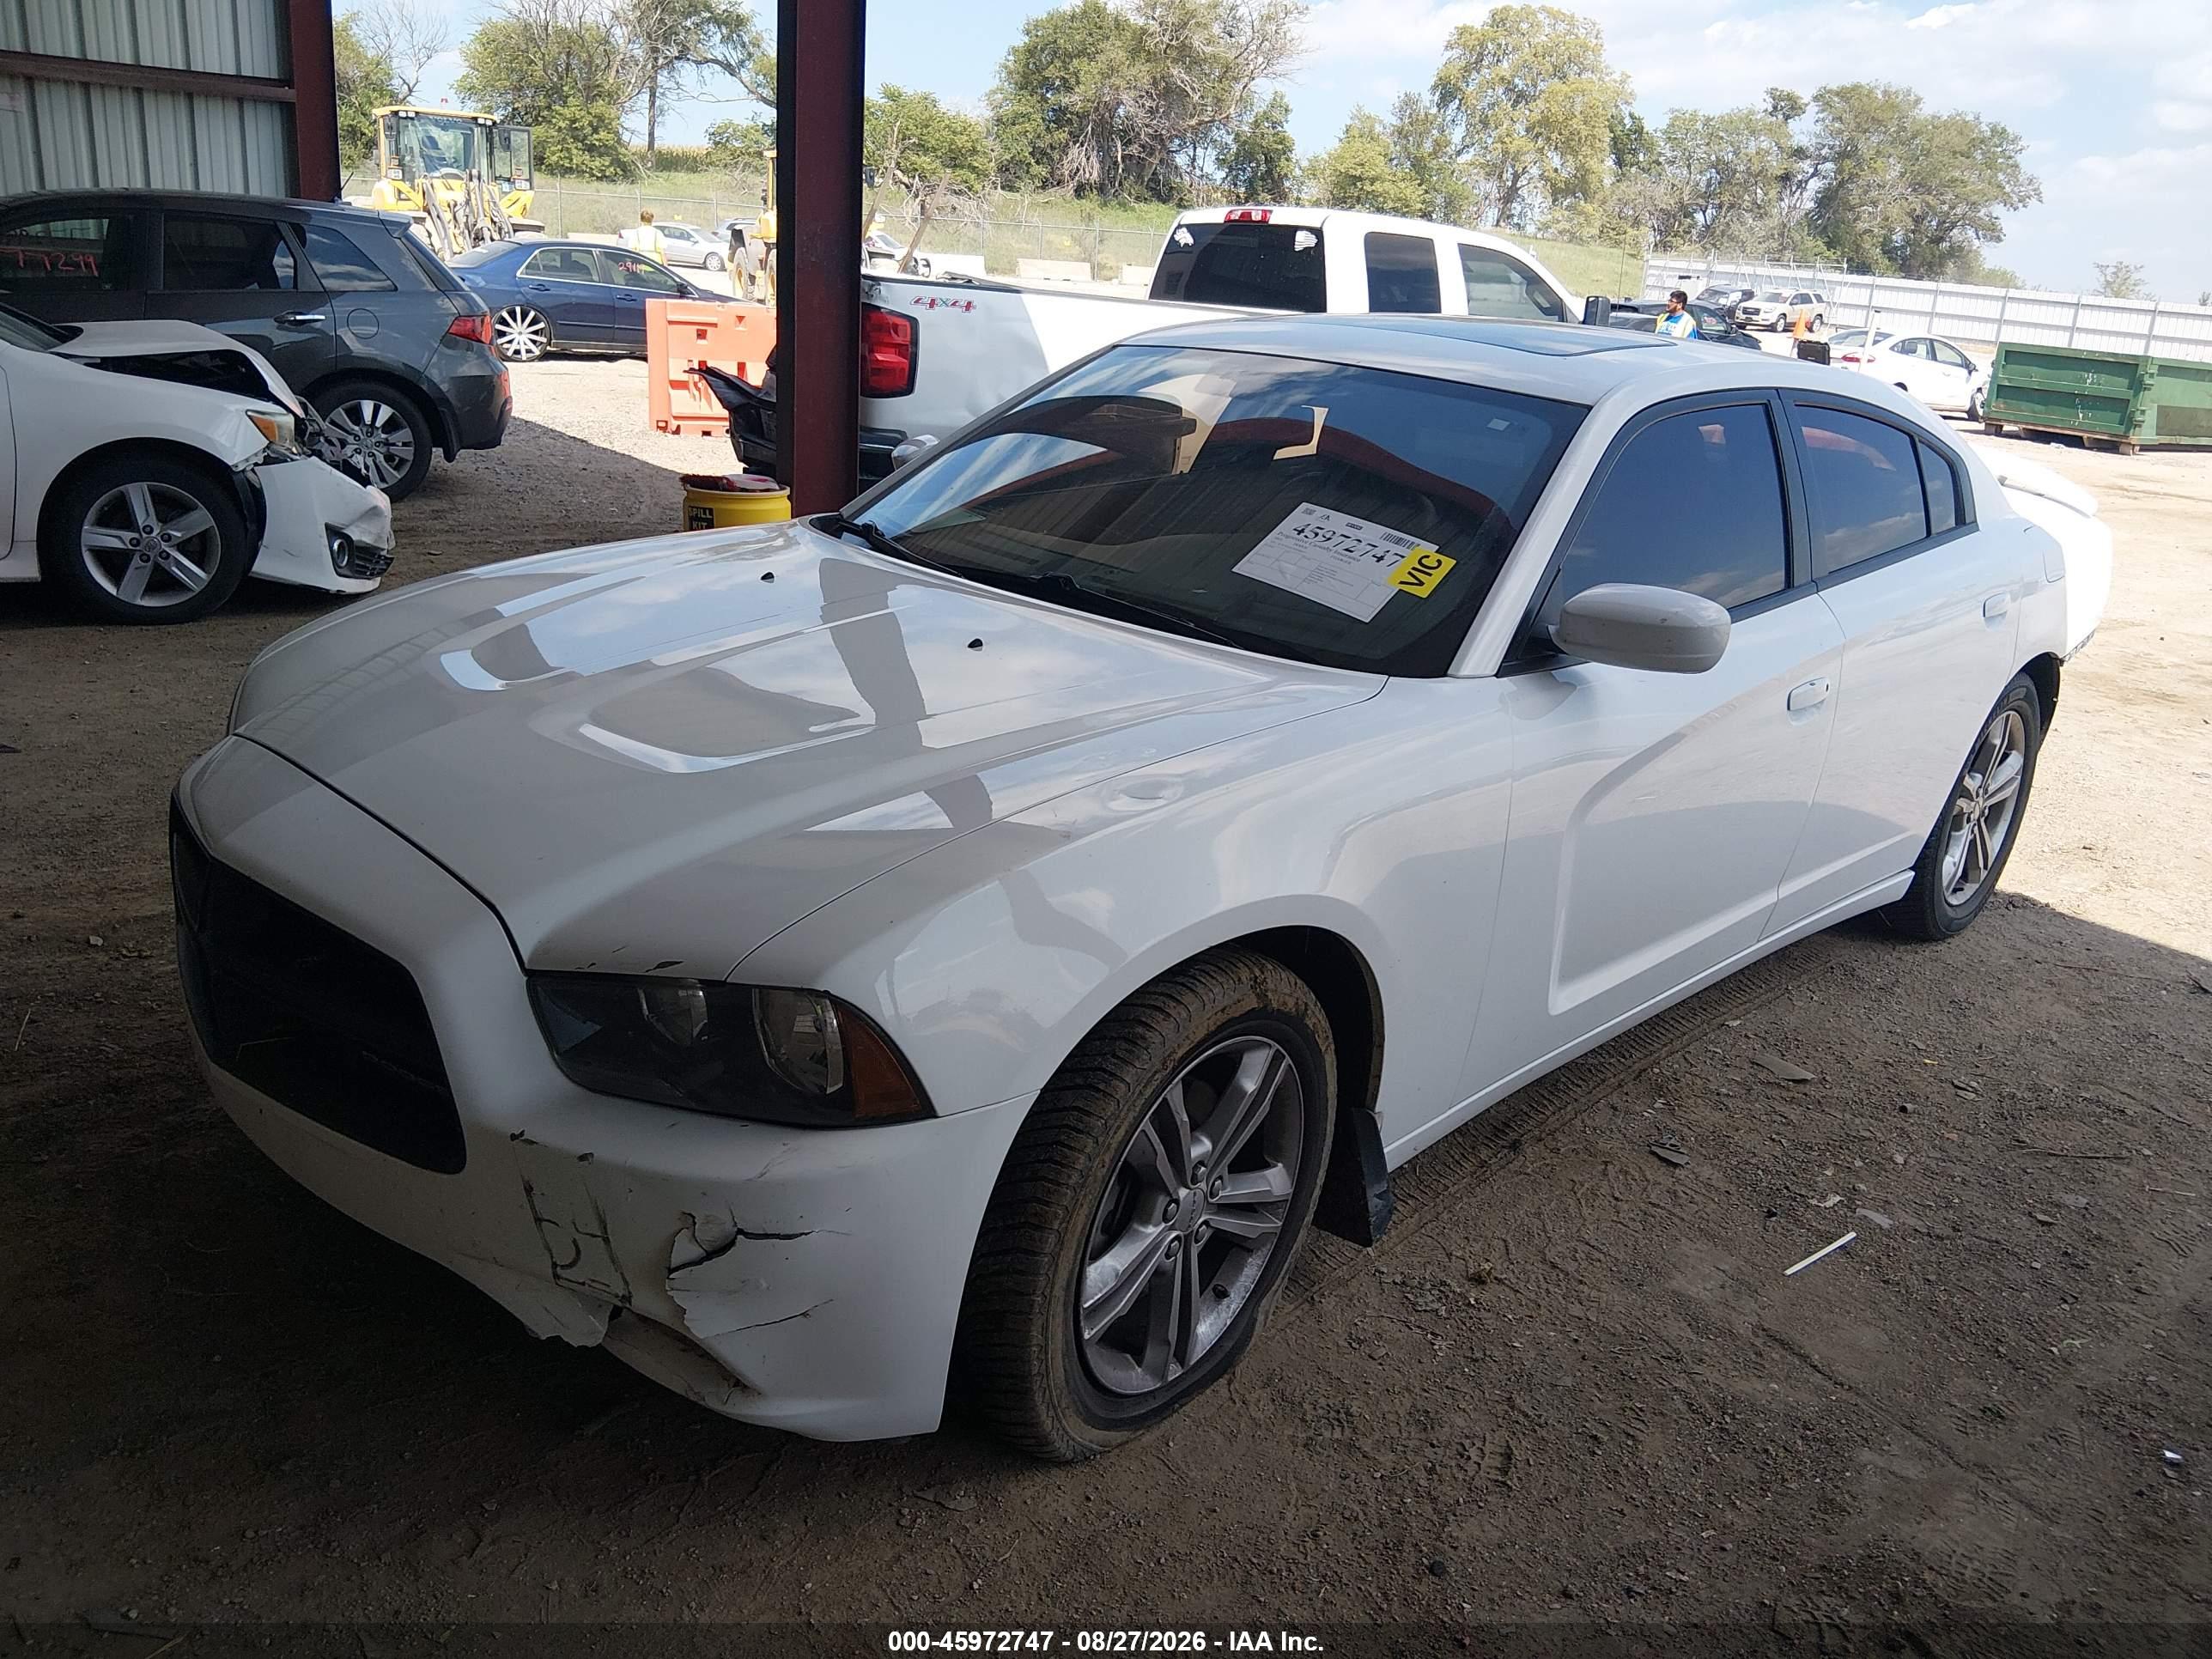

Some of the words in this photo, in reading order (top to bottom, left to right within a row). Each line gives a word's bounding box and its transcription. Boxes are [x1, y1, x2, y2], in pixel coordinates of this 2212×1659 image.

[689, 507, 713, 518] SPILL
[692, 521, 708, 530] KIT
[1292, 523, 1406, 568] 45972747
[1398, 555, 1443, 588] VIC
